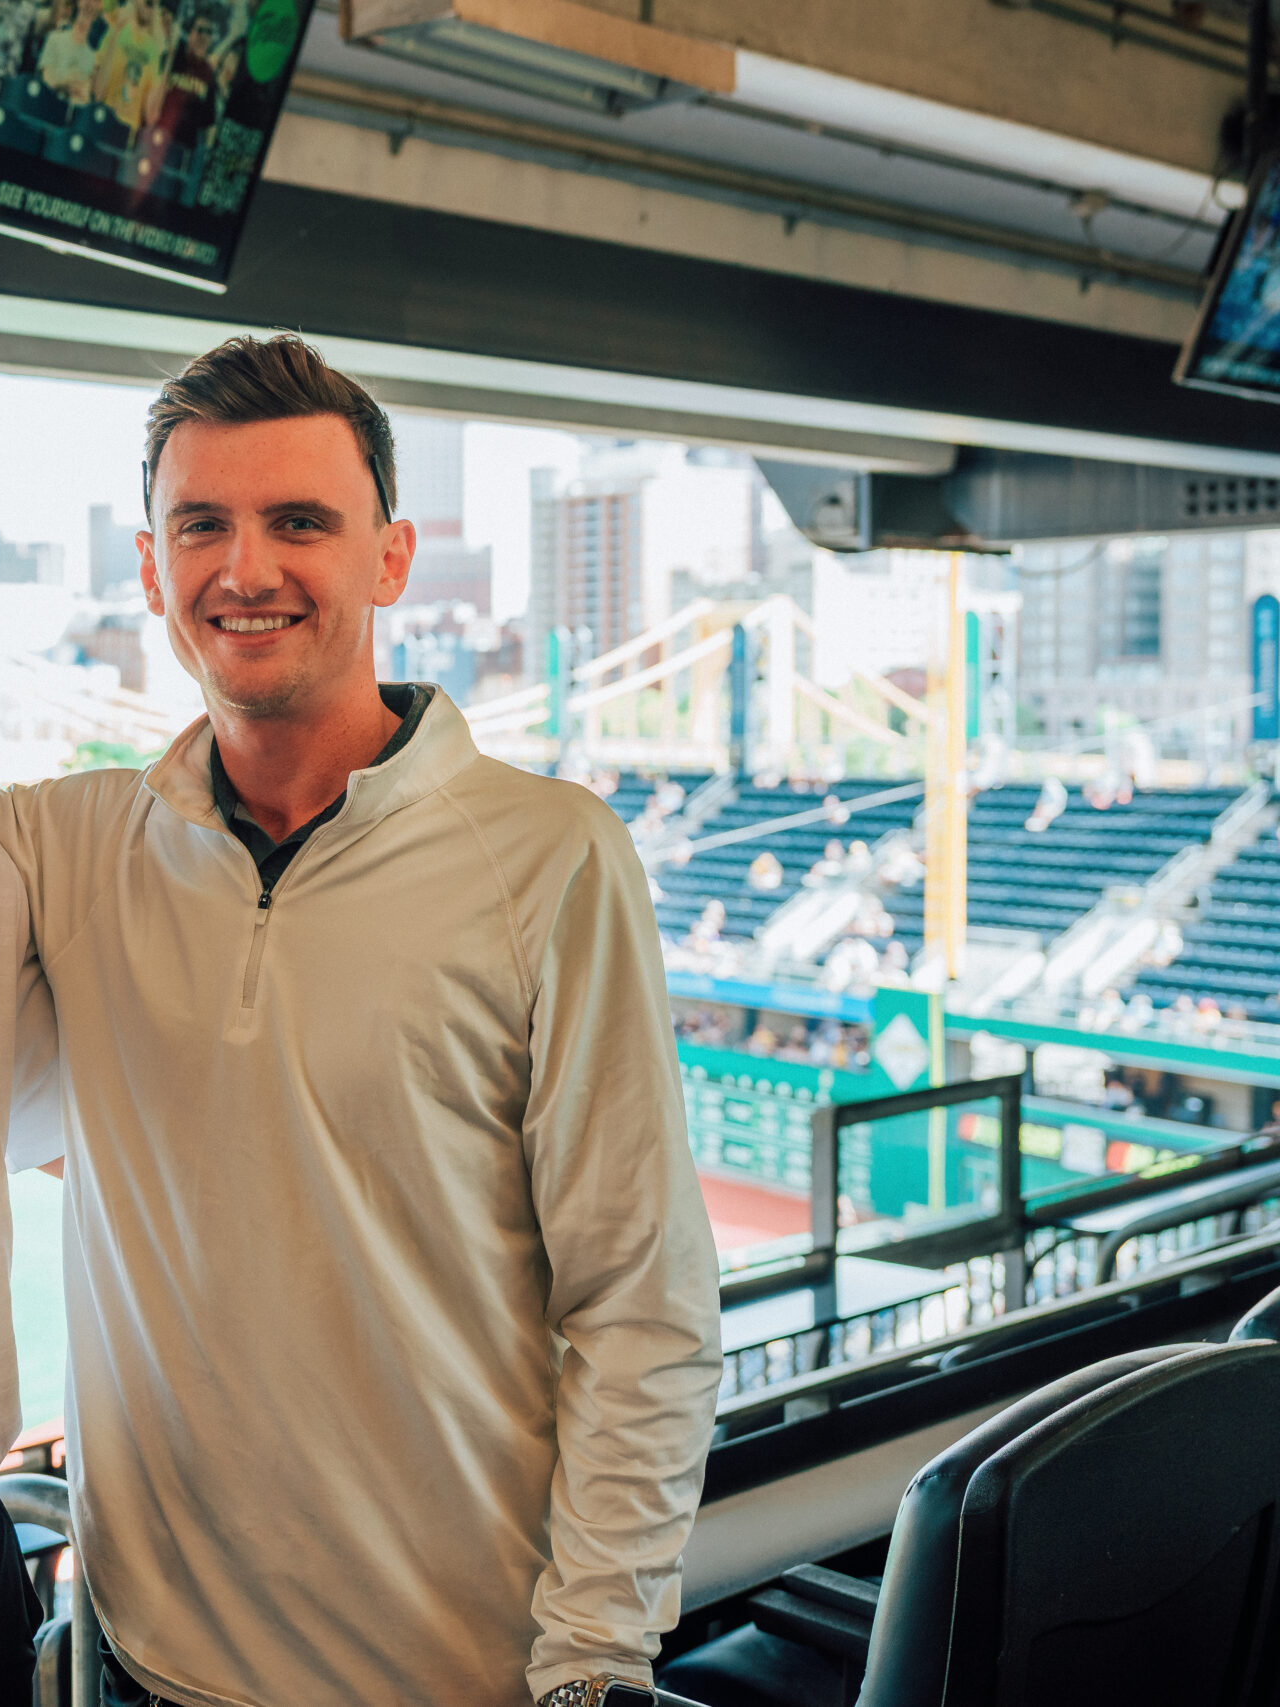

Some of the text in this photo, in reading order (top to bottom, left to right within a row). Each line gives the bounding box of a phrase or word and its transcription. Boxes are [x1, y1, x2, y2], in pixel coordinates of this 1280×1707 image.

[24, 189, 91, 229] YOURSELF
[88, 209, 111, 235] ON
[110, 214, 136, 243] THE
